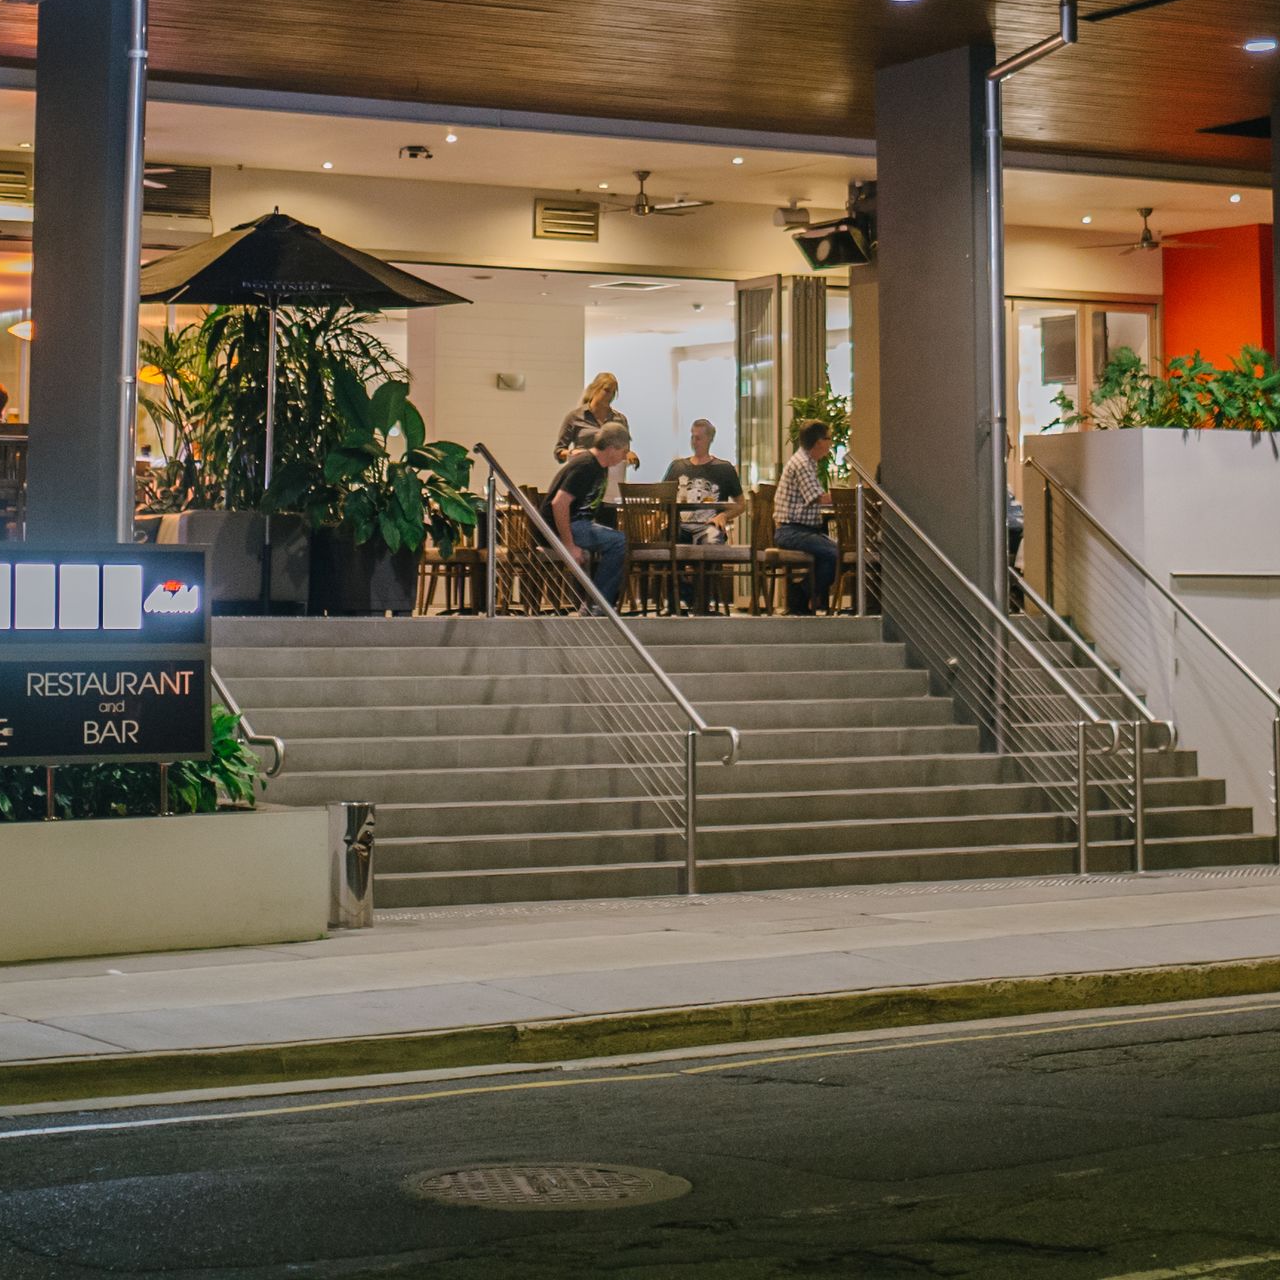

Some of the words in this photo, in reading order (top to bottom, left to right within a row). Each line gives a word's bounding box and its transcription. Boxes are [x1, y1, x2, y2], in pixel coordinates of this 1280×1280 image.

[27, 671, 193, 697] RESTAURANT
[99, 700, 125, 713] and
[83, 720, 139, 745] BAR
